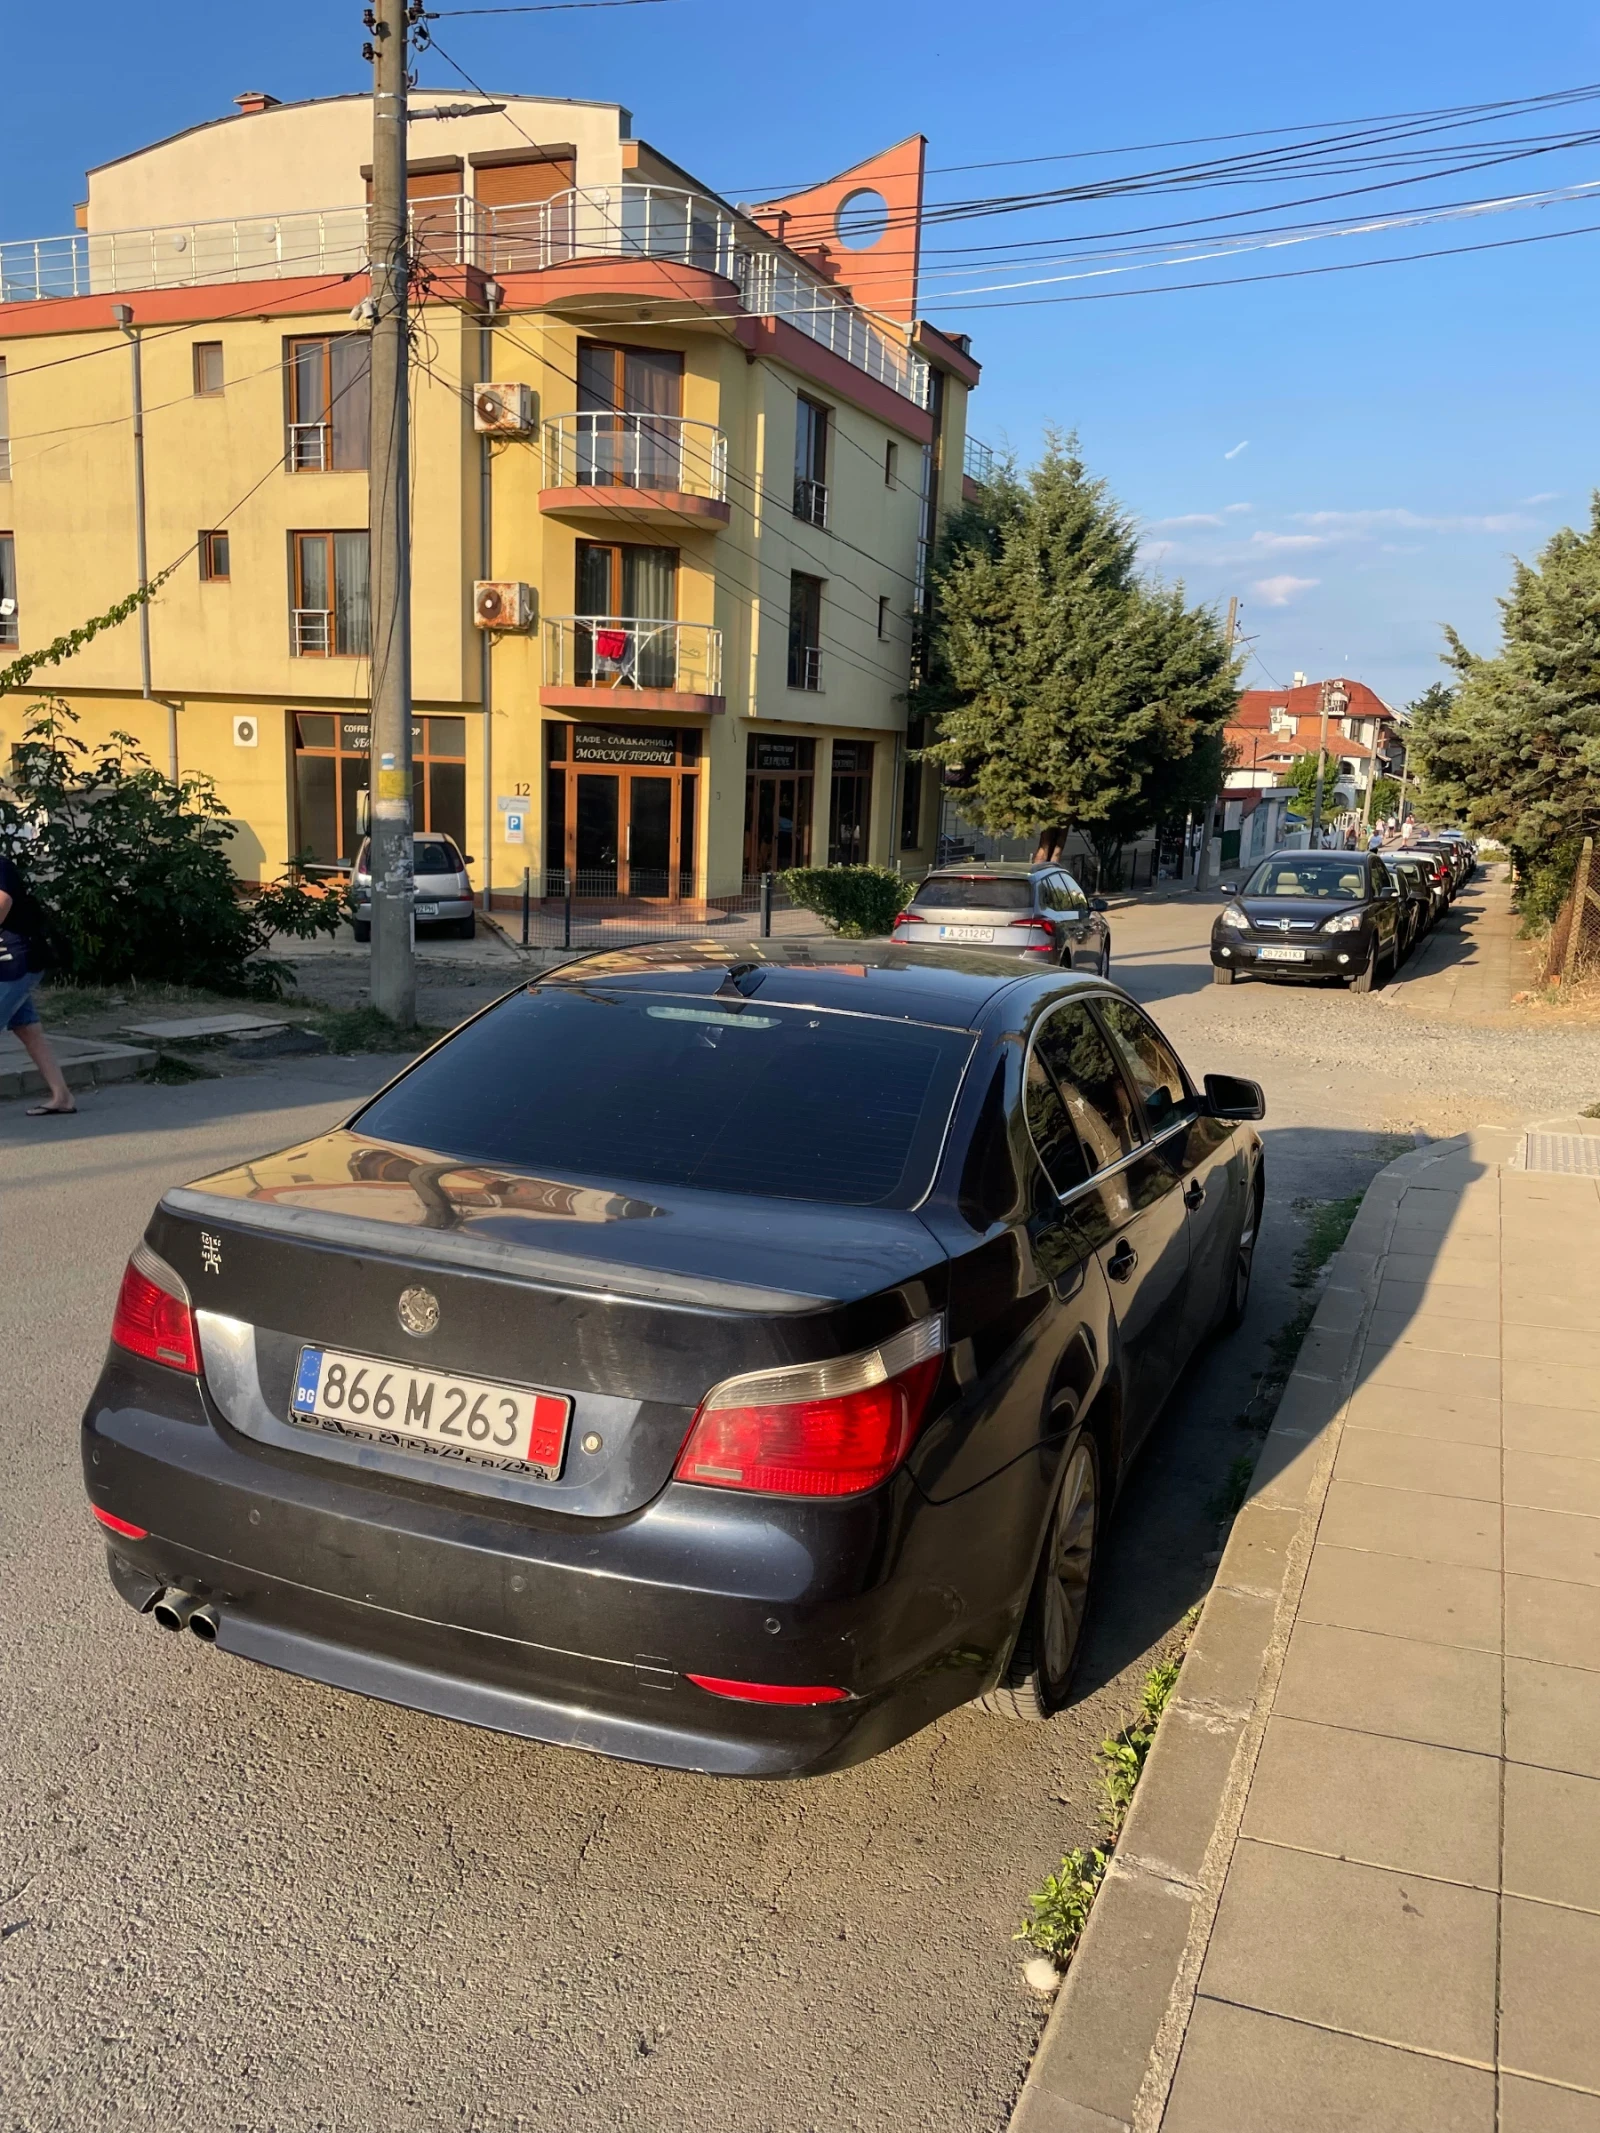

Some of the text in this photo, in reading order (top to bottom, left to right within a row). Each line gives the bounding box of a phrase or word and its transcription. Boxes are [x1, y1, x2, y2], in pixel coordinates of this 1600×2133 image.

[344, 725, 368, 733] COFFEE
[576, 735, 600, 743] КАФЕ
[608, 737, 674, 746] СЛАДКАРНИЦА
[576, 749, 673, 764] МОРСКИ ПРИНЦ
[514, 782, 531, 797] 12
[510, 817, 519, 829] P
[297, 1387, 315, 1404] BG
[323, 1363, 395, 1420] 866
[403, 1378, 435, 1430] M
[439, 1387, 519, 1447] 263
[534, 1438, 555, 1457] 26
